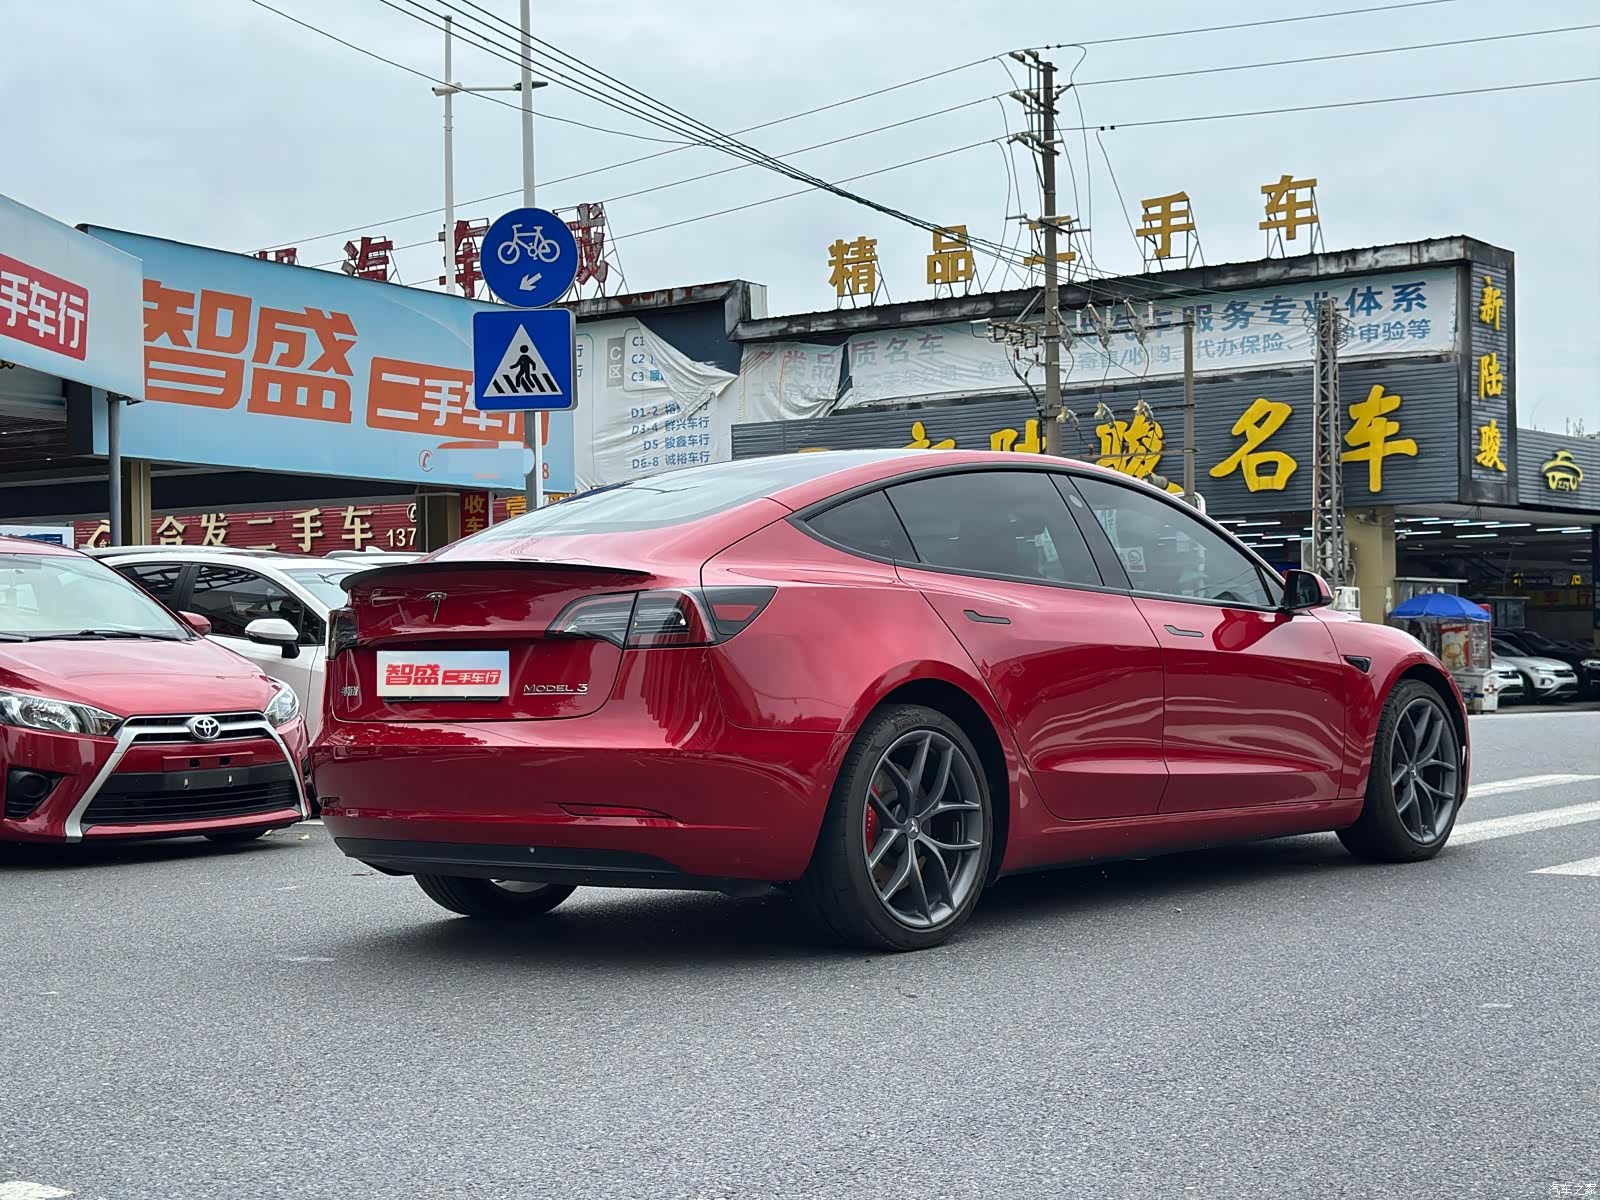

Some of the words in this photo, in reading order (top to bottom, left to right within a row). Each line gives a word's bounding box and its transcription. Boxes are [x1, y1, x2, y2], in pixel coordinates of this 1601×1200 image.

[827, 175, 1319, 296] 精品二手车
[632, 336, 645, 347] C1
[143, 280, 358, 424] 智盛
[631, 354, 645, 365] C2
[631, 372, 645, 382] C3
[1476, 276, 1507, 472] 新陆骏
[376, 372, 526, 436] 二手车
[631, 406, 659, 418] D1-2
[631, 423, 659, 435] D3-4
[643, 438, 659, 451] D5
[632, 456, 659, 469] D6-8
[157, 505, 374, 553] 合发二手车
[385, 663, 440, 686] 智盛
[444, 671, 500, 685] 二手车行
[523, 684, 574, 693] MODEL
[576, 683, 588, 692] 3
